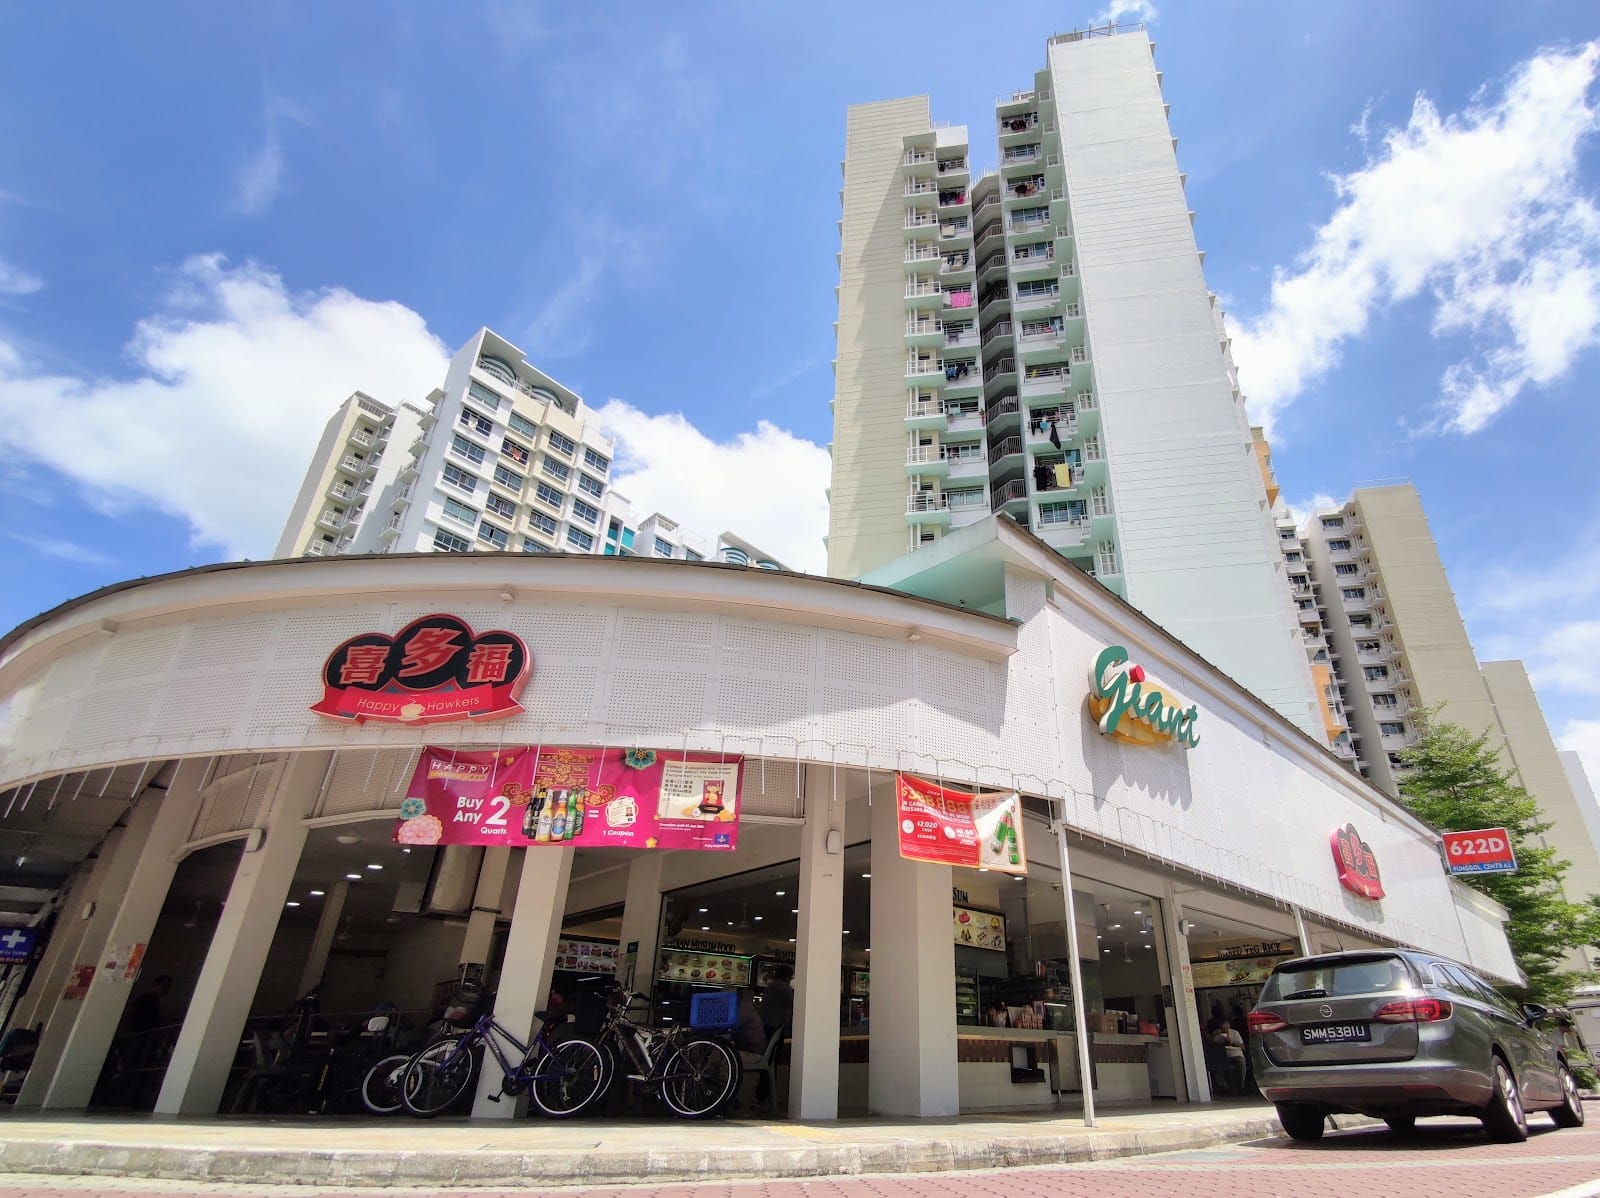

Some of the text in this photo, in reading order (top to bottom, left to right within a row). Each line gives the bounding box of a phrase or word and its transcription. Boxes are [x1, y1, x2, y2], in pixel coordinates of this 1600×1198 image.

[338, 627, 515, 685] 喜多福
[1094, 645, 1200, 748] Giant
[357, 696, 480, 713] Happy Hawkers
[432, 761, 489, 774] HAPPY
[457, 796, 484, 810] Buy
[453, 795, 511, 826] Any 2
[480, 826, 507, 835] Quarts
[1450, 837, 1505, 857] 622D
[1453, 861, 1512, 872] PUNGGOL CENTRAL
[718, 942, 736, 954] FOOD
[1262, 942, 1281, 953] RICE
[1303, 1025, 1365, 1040] SMM5381U
